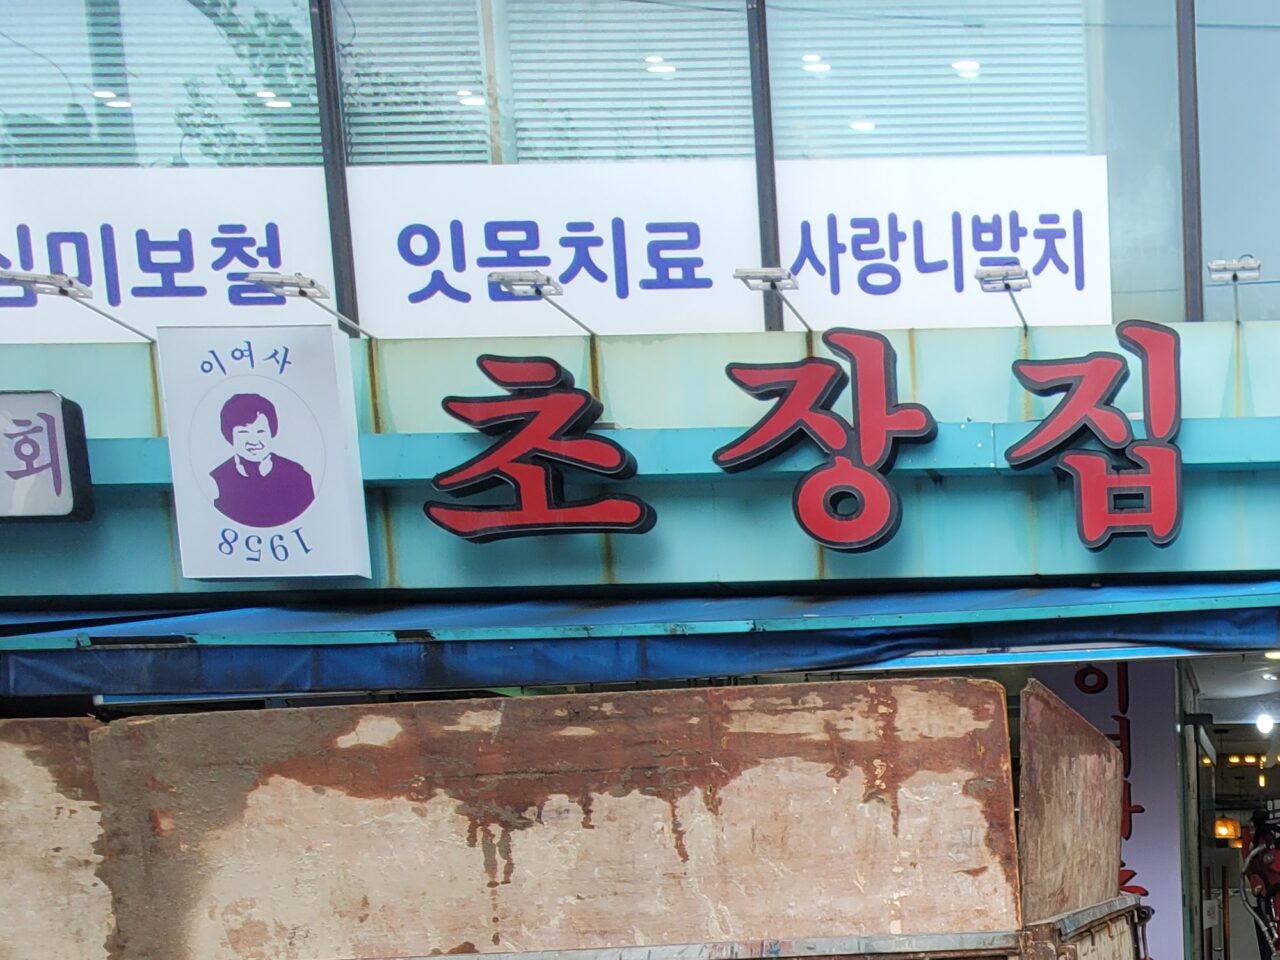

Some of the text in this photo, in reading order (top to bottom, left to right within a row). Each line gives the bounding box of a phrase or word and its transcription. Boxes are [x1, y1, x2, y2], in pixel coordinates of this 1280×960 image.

[397, 216, 714, 304] 잇몸치료
[200, 340, 293, 376] 이여사
[2, 411, 63, 498] 회
[423, 319, 1182, 554] 초장집
